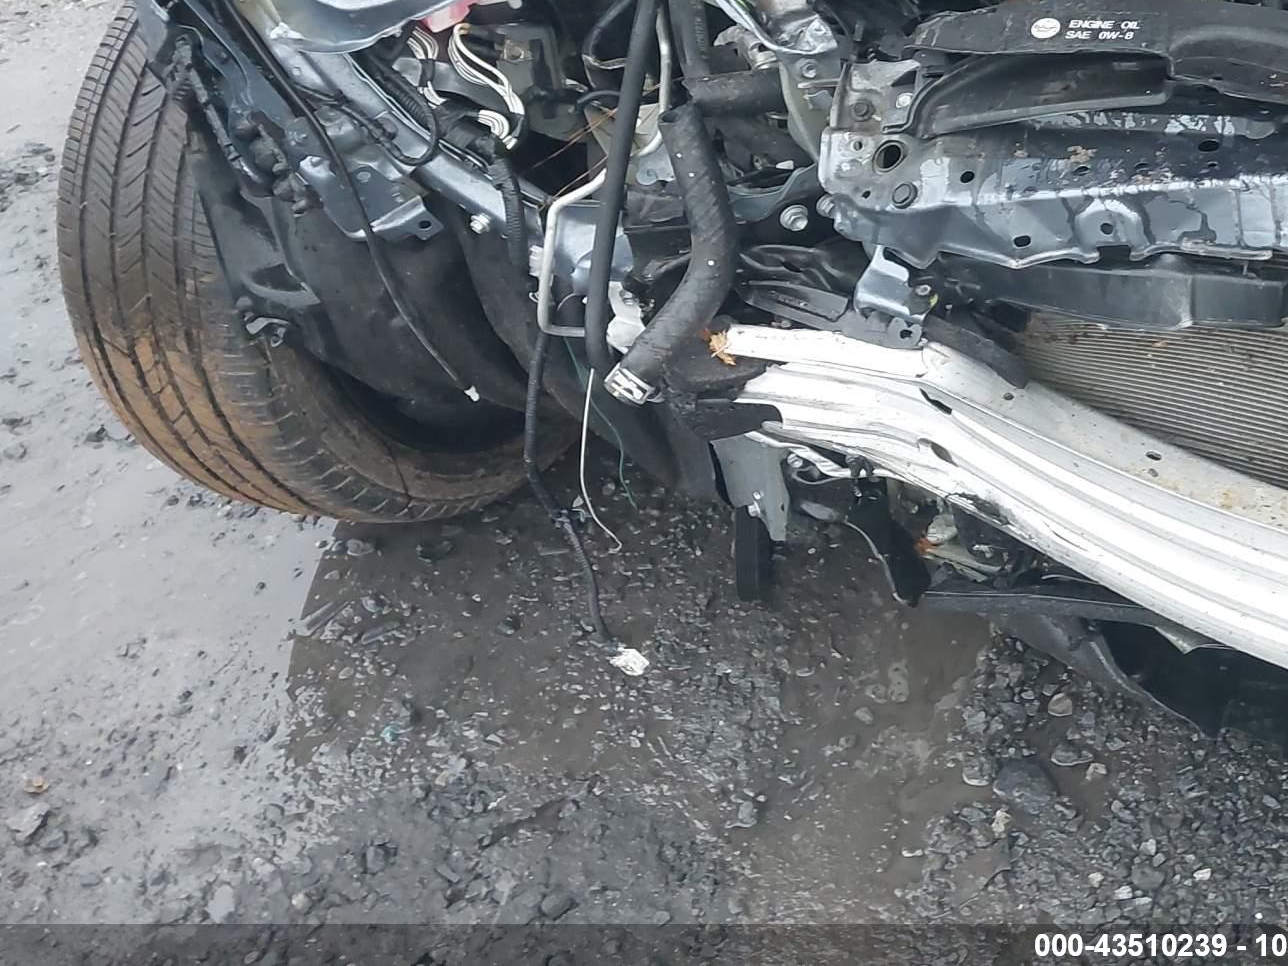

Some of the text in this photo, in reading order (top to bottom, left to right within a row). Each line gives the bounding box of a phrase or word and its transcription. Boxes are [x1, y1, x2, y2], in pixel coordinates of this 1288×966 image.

[1068, 19, 1141, 30] ENGINE OIL
[1064, 30, 1092, 40] SAE
